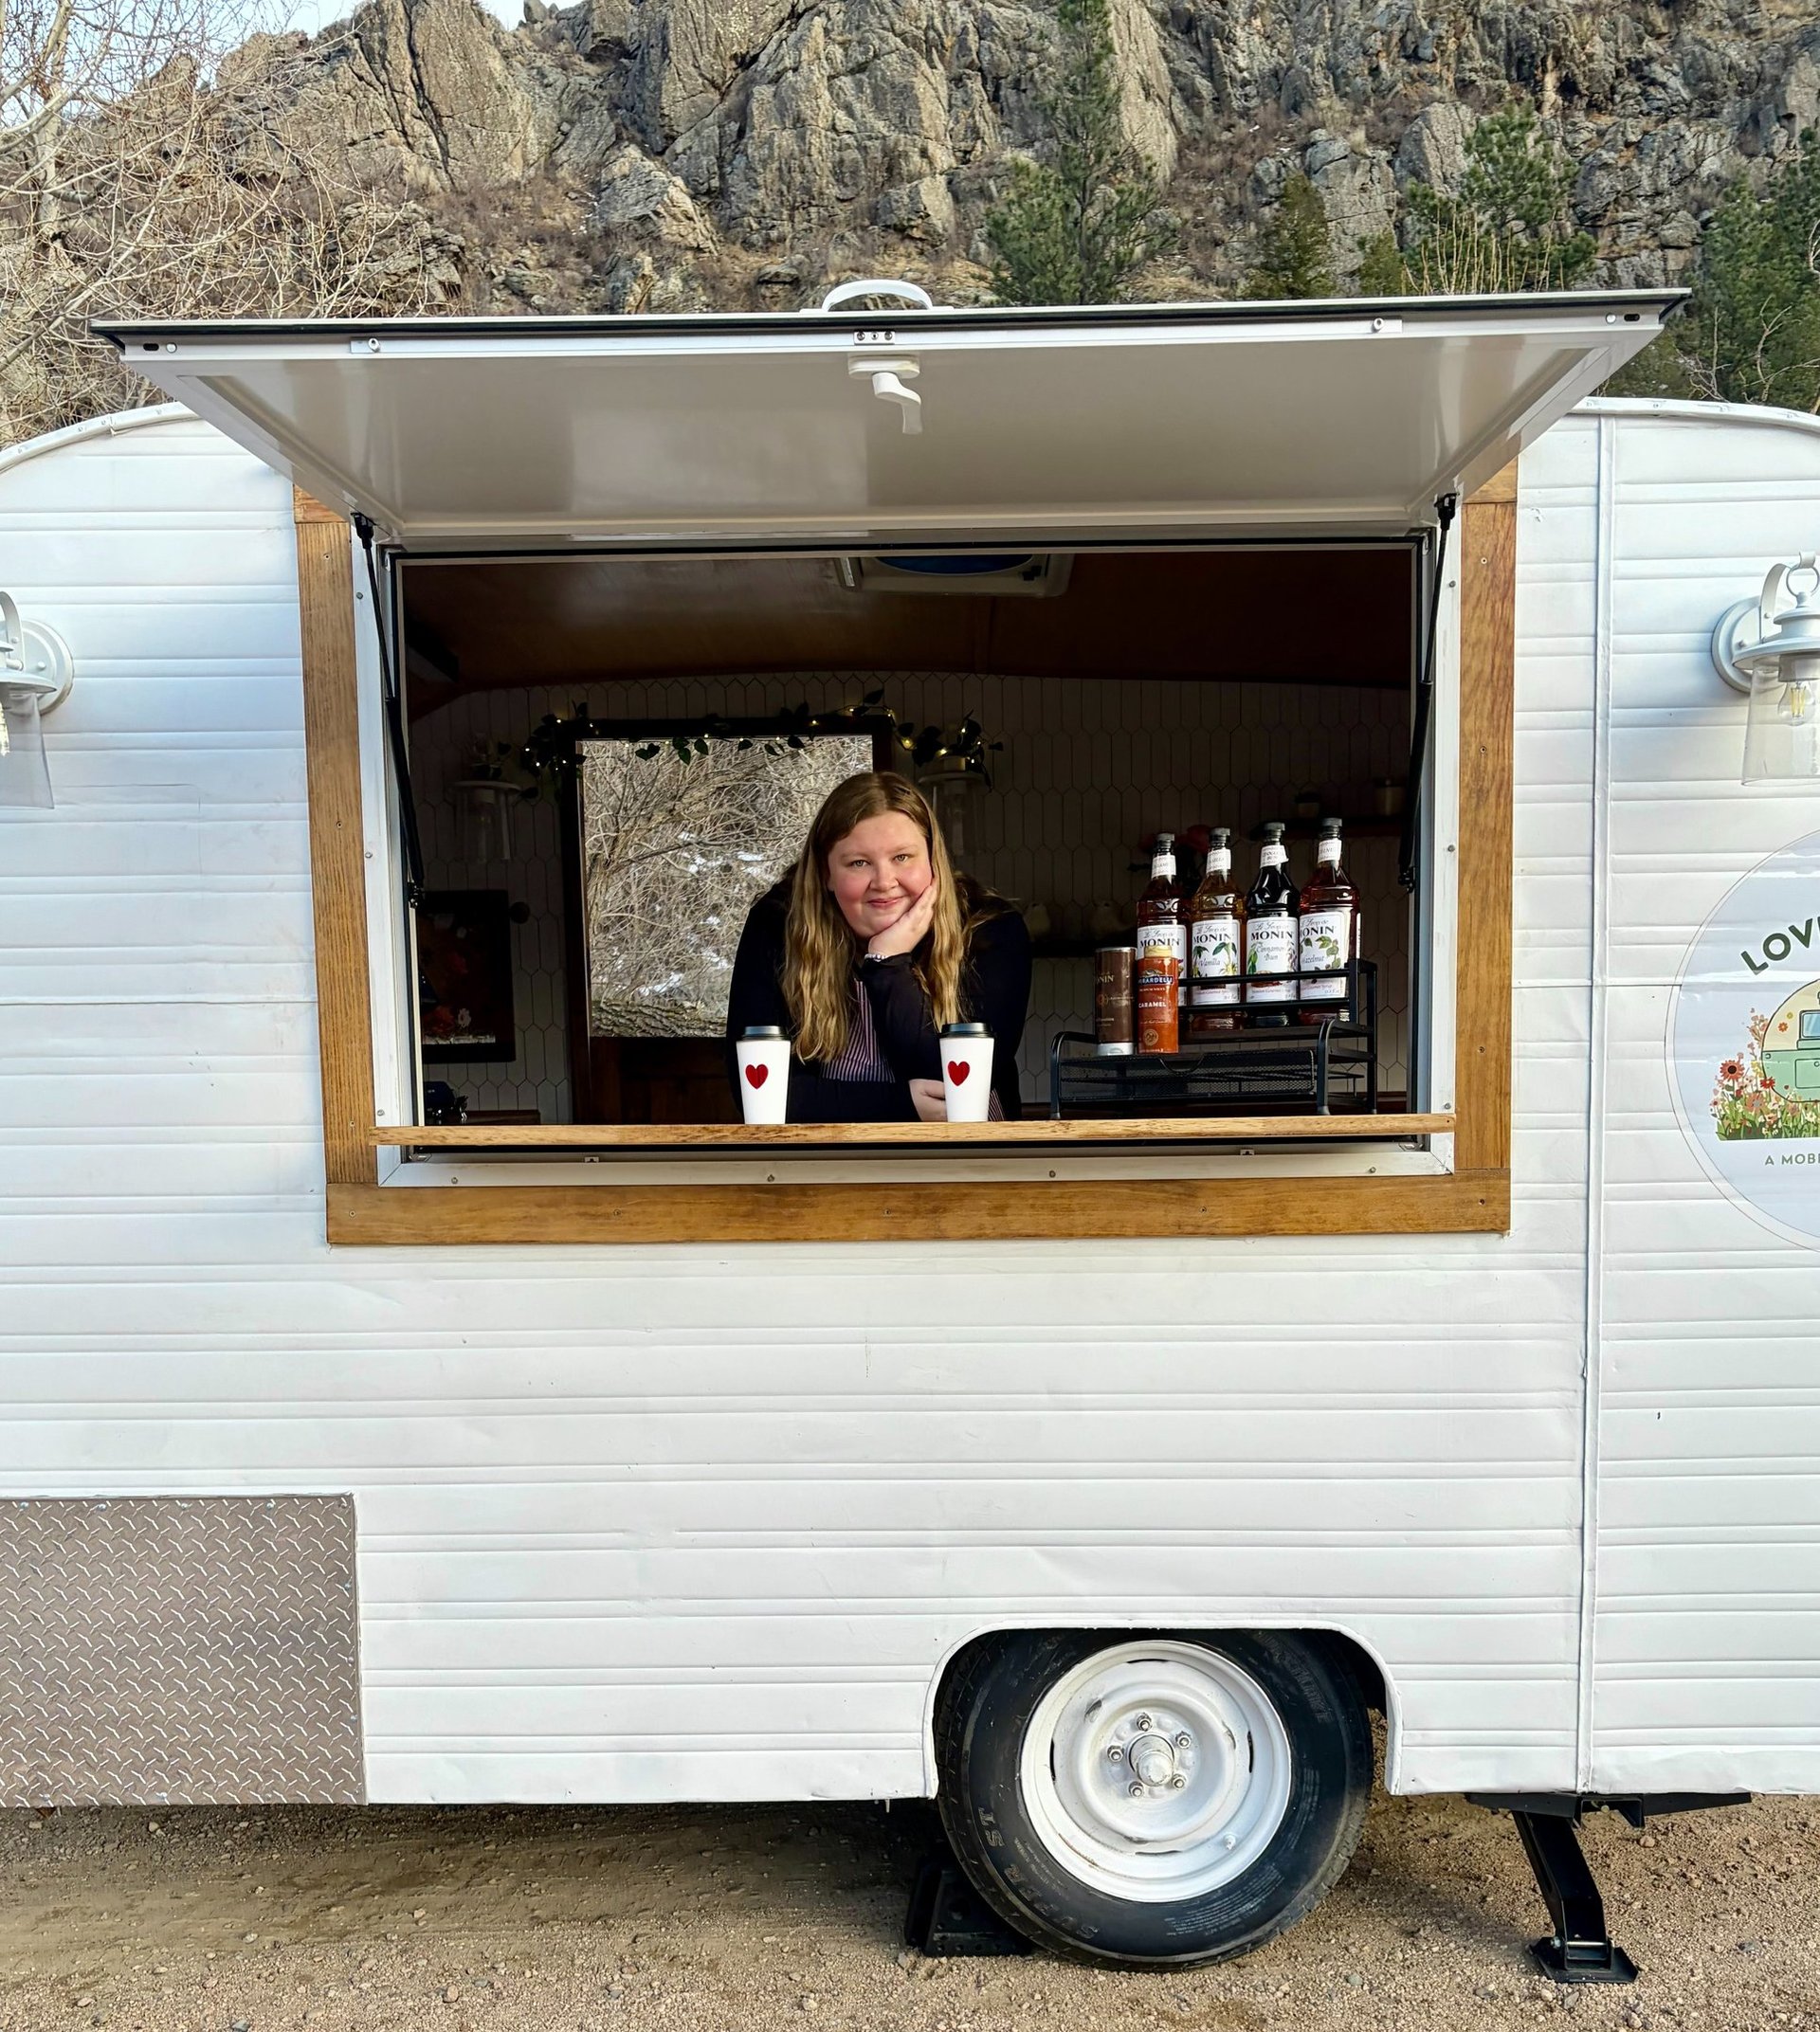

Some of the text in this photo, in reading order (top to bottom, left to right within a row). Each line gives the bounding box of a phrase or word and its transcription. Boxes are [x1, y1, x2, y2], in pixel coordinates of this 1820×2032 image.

[1193, 934, 1233, 943] MONIN
[1251, 931, 1293, 940] MONIN
[1139, 937, 1180, 948] MONIN
[1740, 916, 1820, 975] LOV
[1199, 957, 1221, 967] Vanilla
[1097, 974, 1115, 983] NIN
[1765, 1155, 1774, 1166] A
